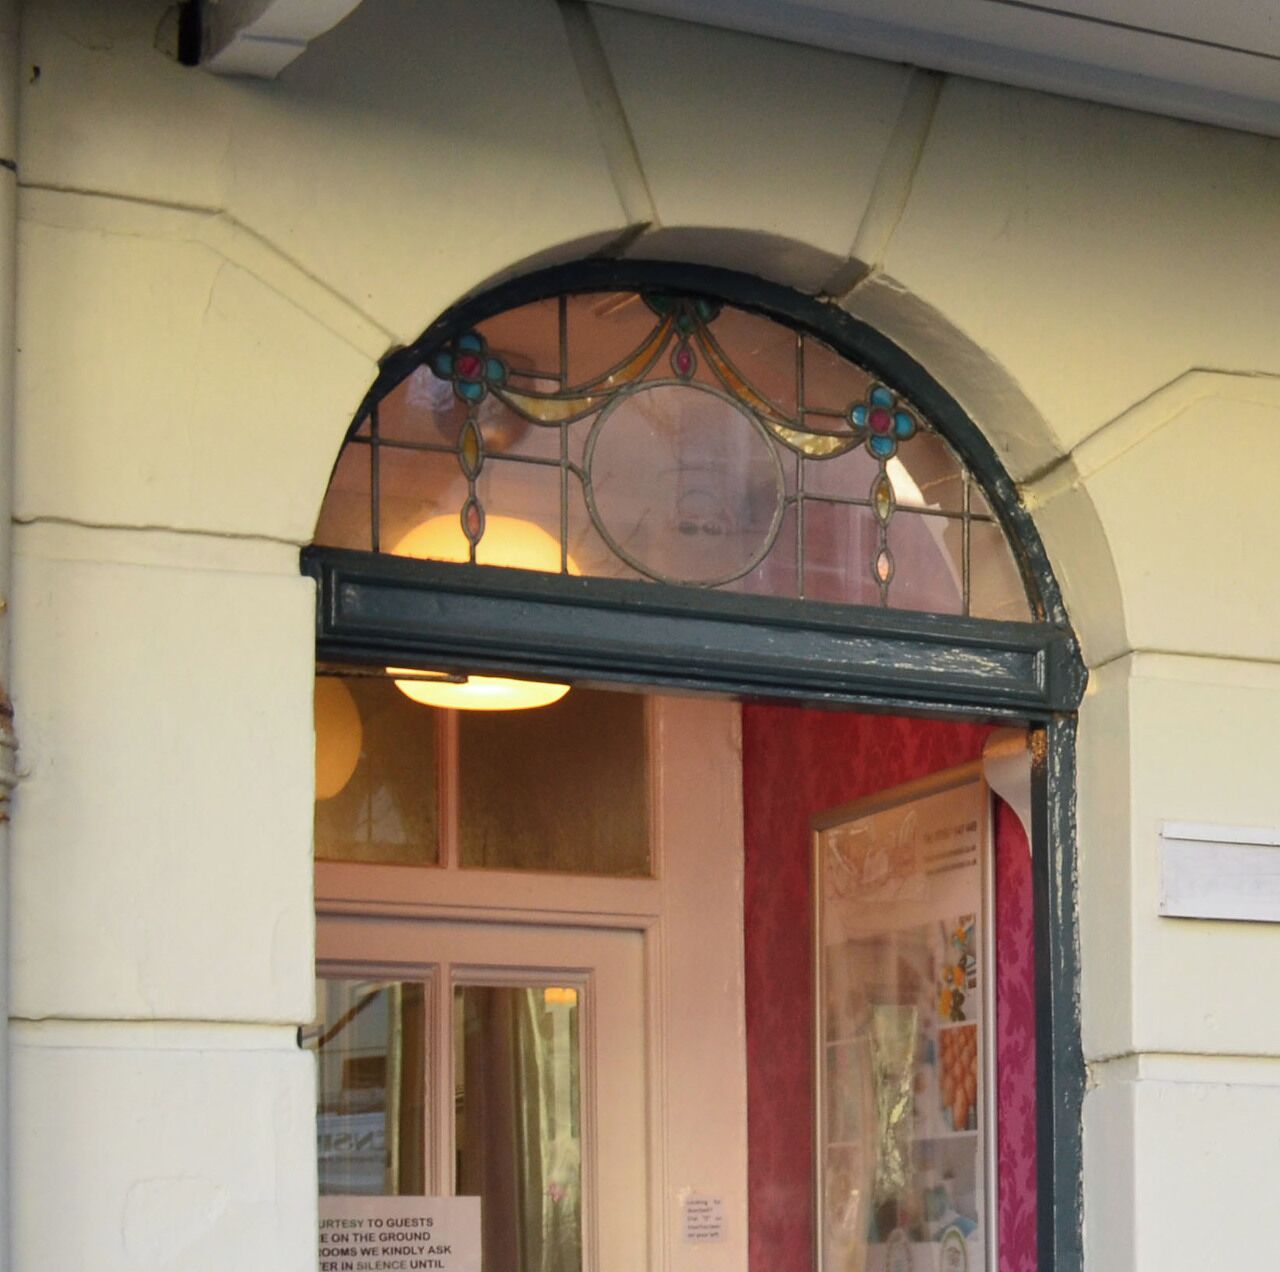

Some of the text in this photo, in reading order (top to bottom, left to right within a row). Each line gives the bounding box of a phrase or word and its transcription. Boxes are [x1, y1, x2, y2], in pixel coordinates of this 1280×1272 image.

[367, 1218, 384, 1228] TO
[386, 1217, 434, 1228] GUESTS
[331, 1233, 350, 1243] ON
[352, 1232, 376, 1243] THE
[378, 1232, 431, 1243] GROUND
[360, 1246, 379, 1256] WE
[382, 1246, 424, 1256] KINDLY
[427, 1245, 452, 1255] ASK
[341, 1261, 353, 1271] IN
[356, 1260, 408, 1271] SILENCE
[410, 1259, 445, 1269] UNTIL
